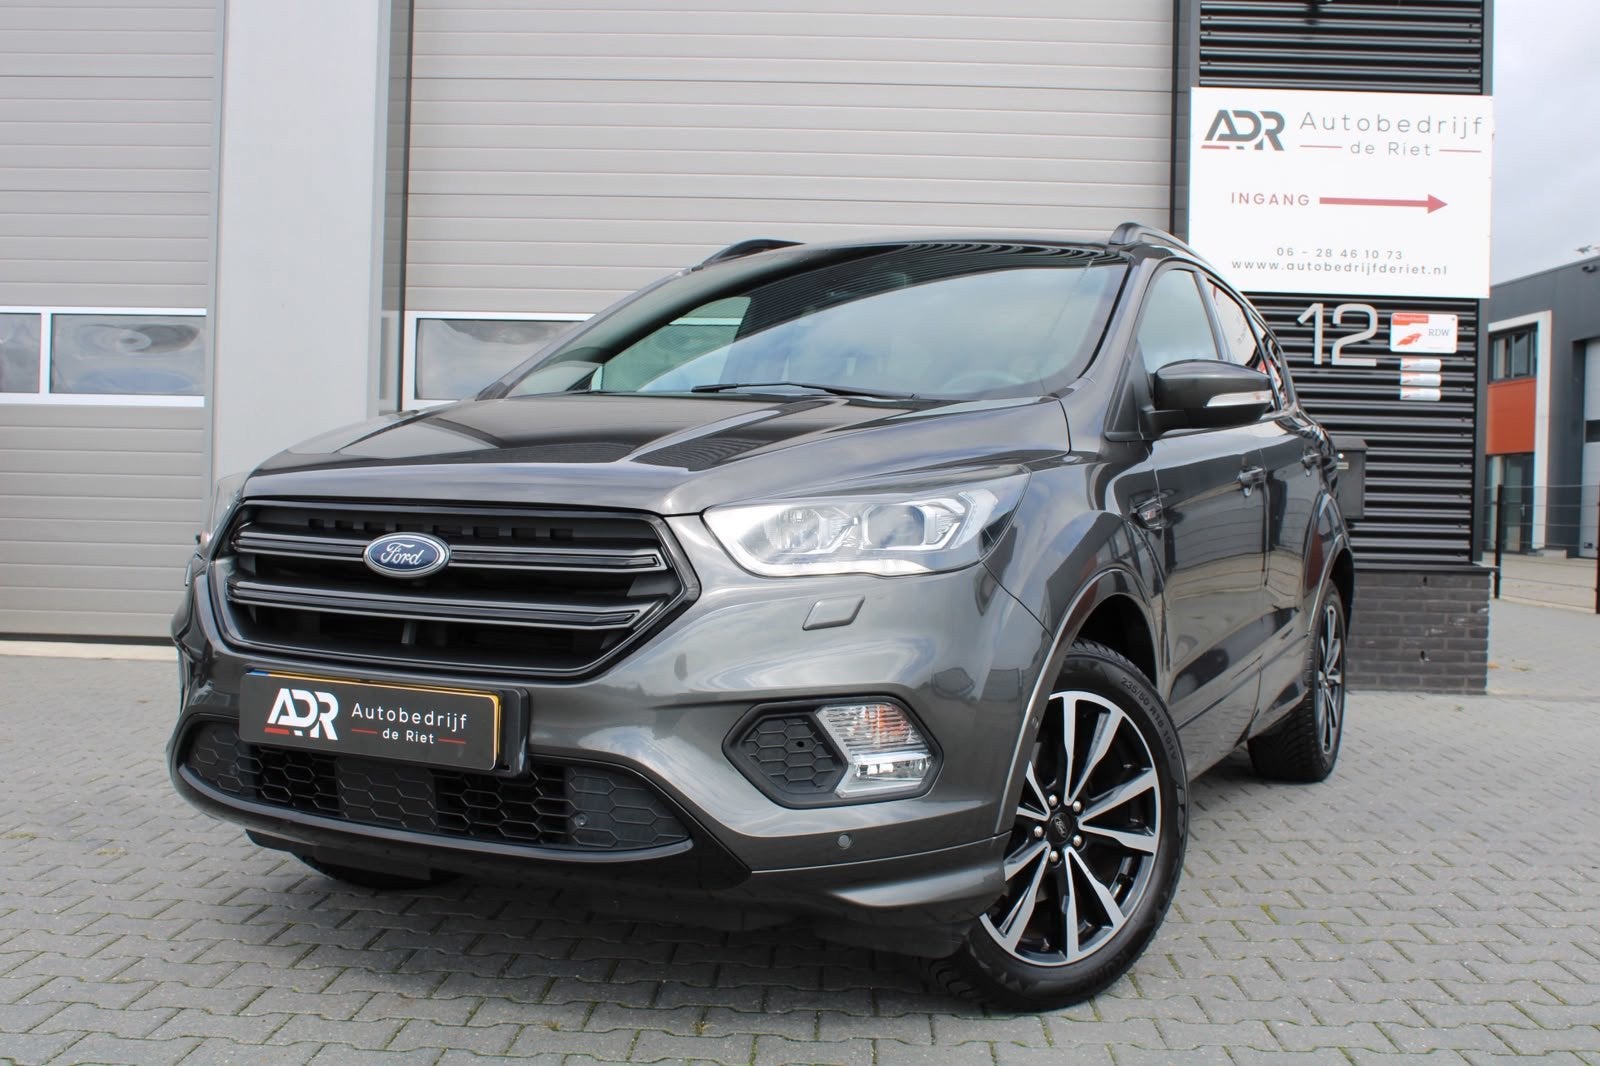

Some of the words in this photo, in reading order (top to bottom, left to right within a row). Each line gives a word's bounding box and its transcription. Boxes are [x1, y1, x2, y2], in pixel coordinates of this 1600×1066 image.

[1202, 109, 1285, 151] ADR
[1299, 111, 1482, 140] Autobedrijf
[1350, 141, 1375, 155] de
[1388, 142, 1431, 156] Riet
[1231, 192, 1310, 206] INGANG
[1276, 247, 1294, 257] 06
[1316, 248, 1333, 258] 28
[1340, 249, 1358, 259] 46
[1364, 249, 1379, 259] 10
[1386, 250, 1403, 260] 73
[1297, 303, 1378, 366] 12
[1428, 328, 1450, 337] RDW
[380, 542, 424, 565] Ford
[264, 687, 339, 741] ADR
[351, 702, 468, 733] Autobedrijf
[382, 727, 399, 740] de
[405, 730, 435, 744] Riet
